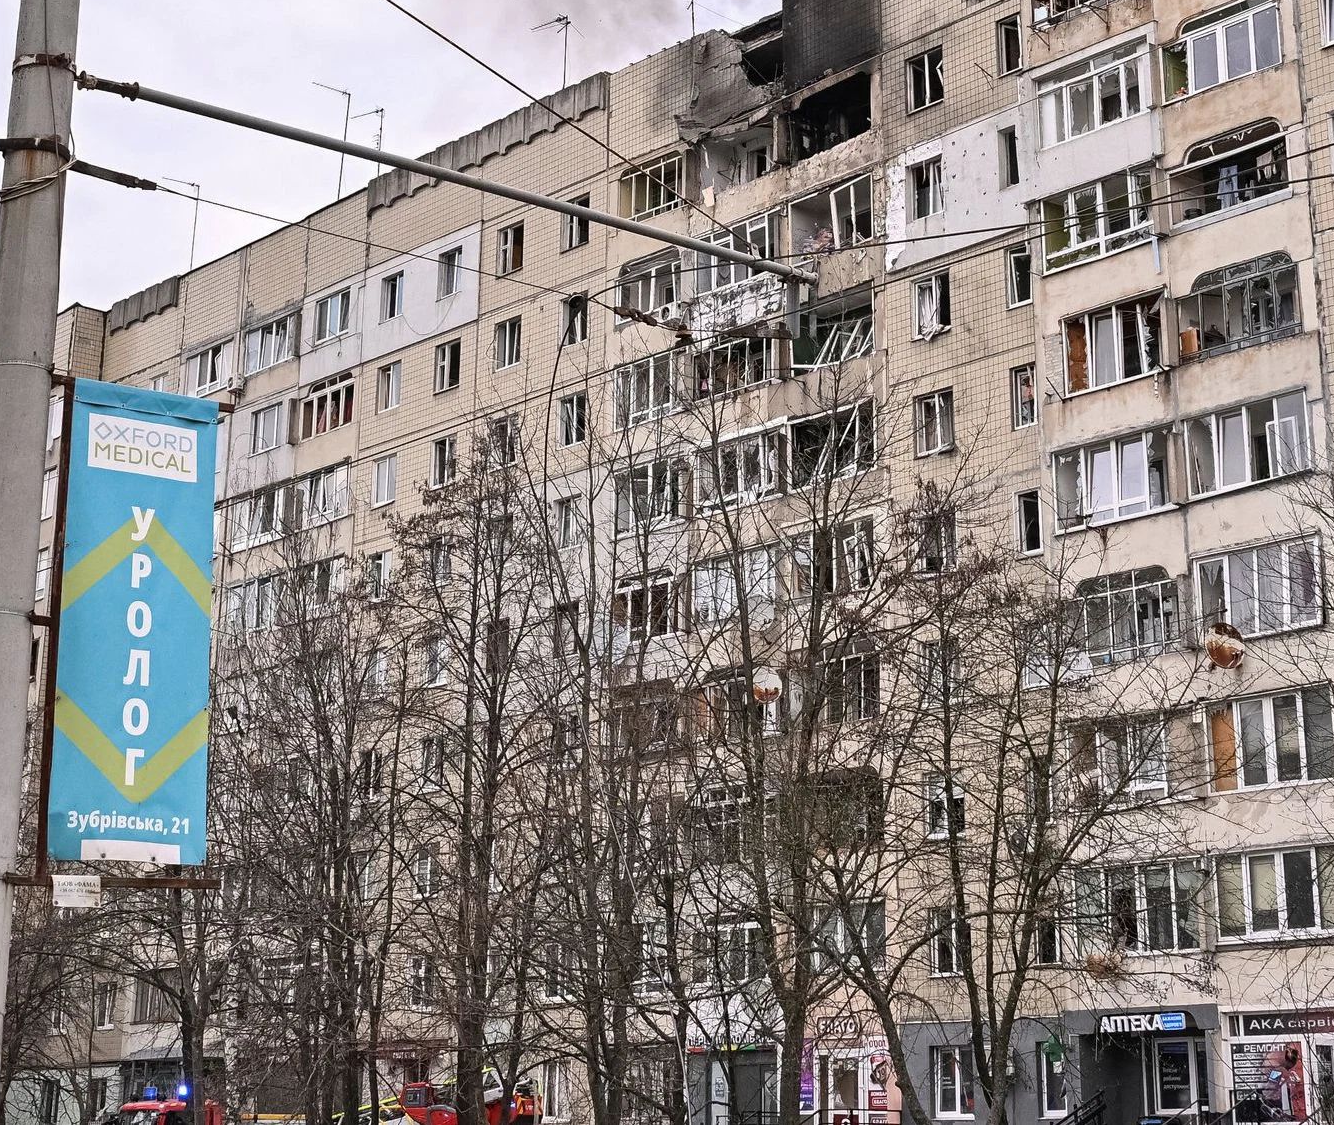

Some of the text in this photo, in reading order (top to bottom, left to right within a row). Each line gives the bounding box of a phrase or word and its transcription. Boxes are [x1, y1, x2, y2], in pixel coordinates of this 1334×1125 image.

[94, 421, 193, 453] OXFORD
[94, 441, 191, 473] MEDICAL
[122, 505, 156, 786] УРОЛОГ
[66, 810, 190, 836] Зубрівська, 21
[1100, 1014, 1164, 1033] АПТЕКА
[1249, 1019, 1285, 1030] АКА
[1243, 1043, 1286, 1054] РЕМОНТ
